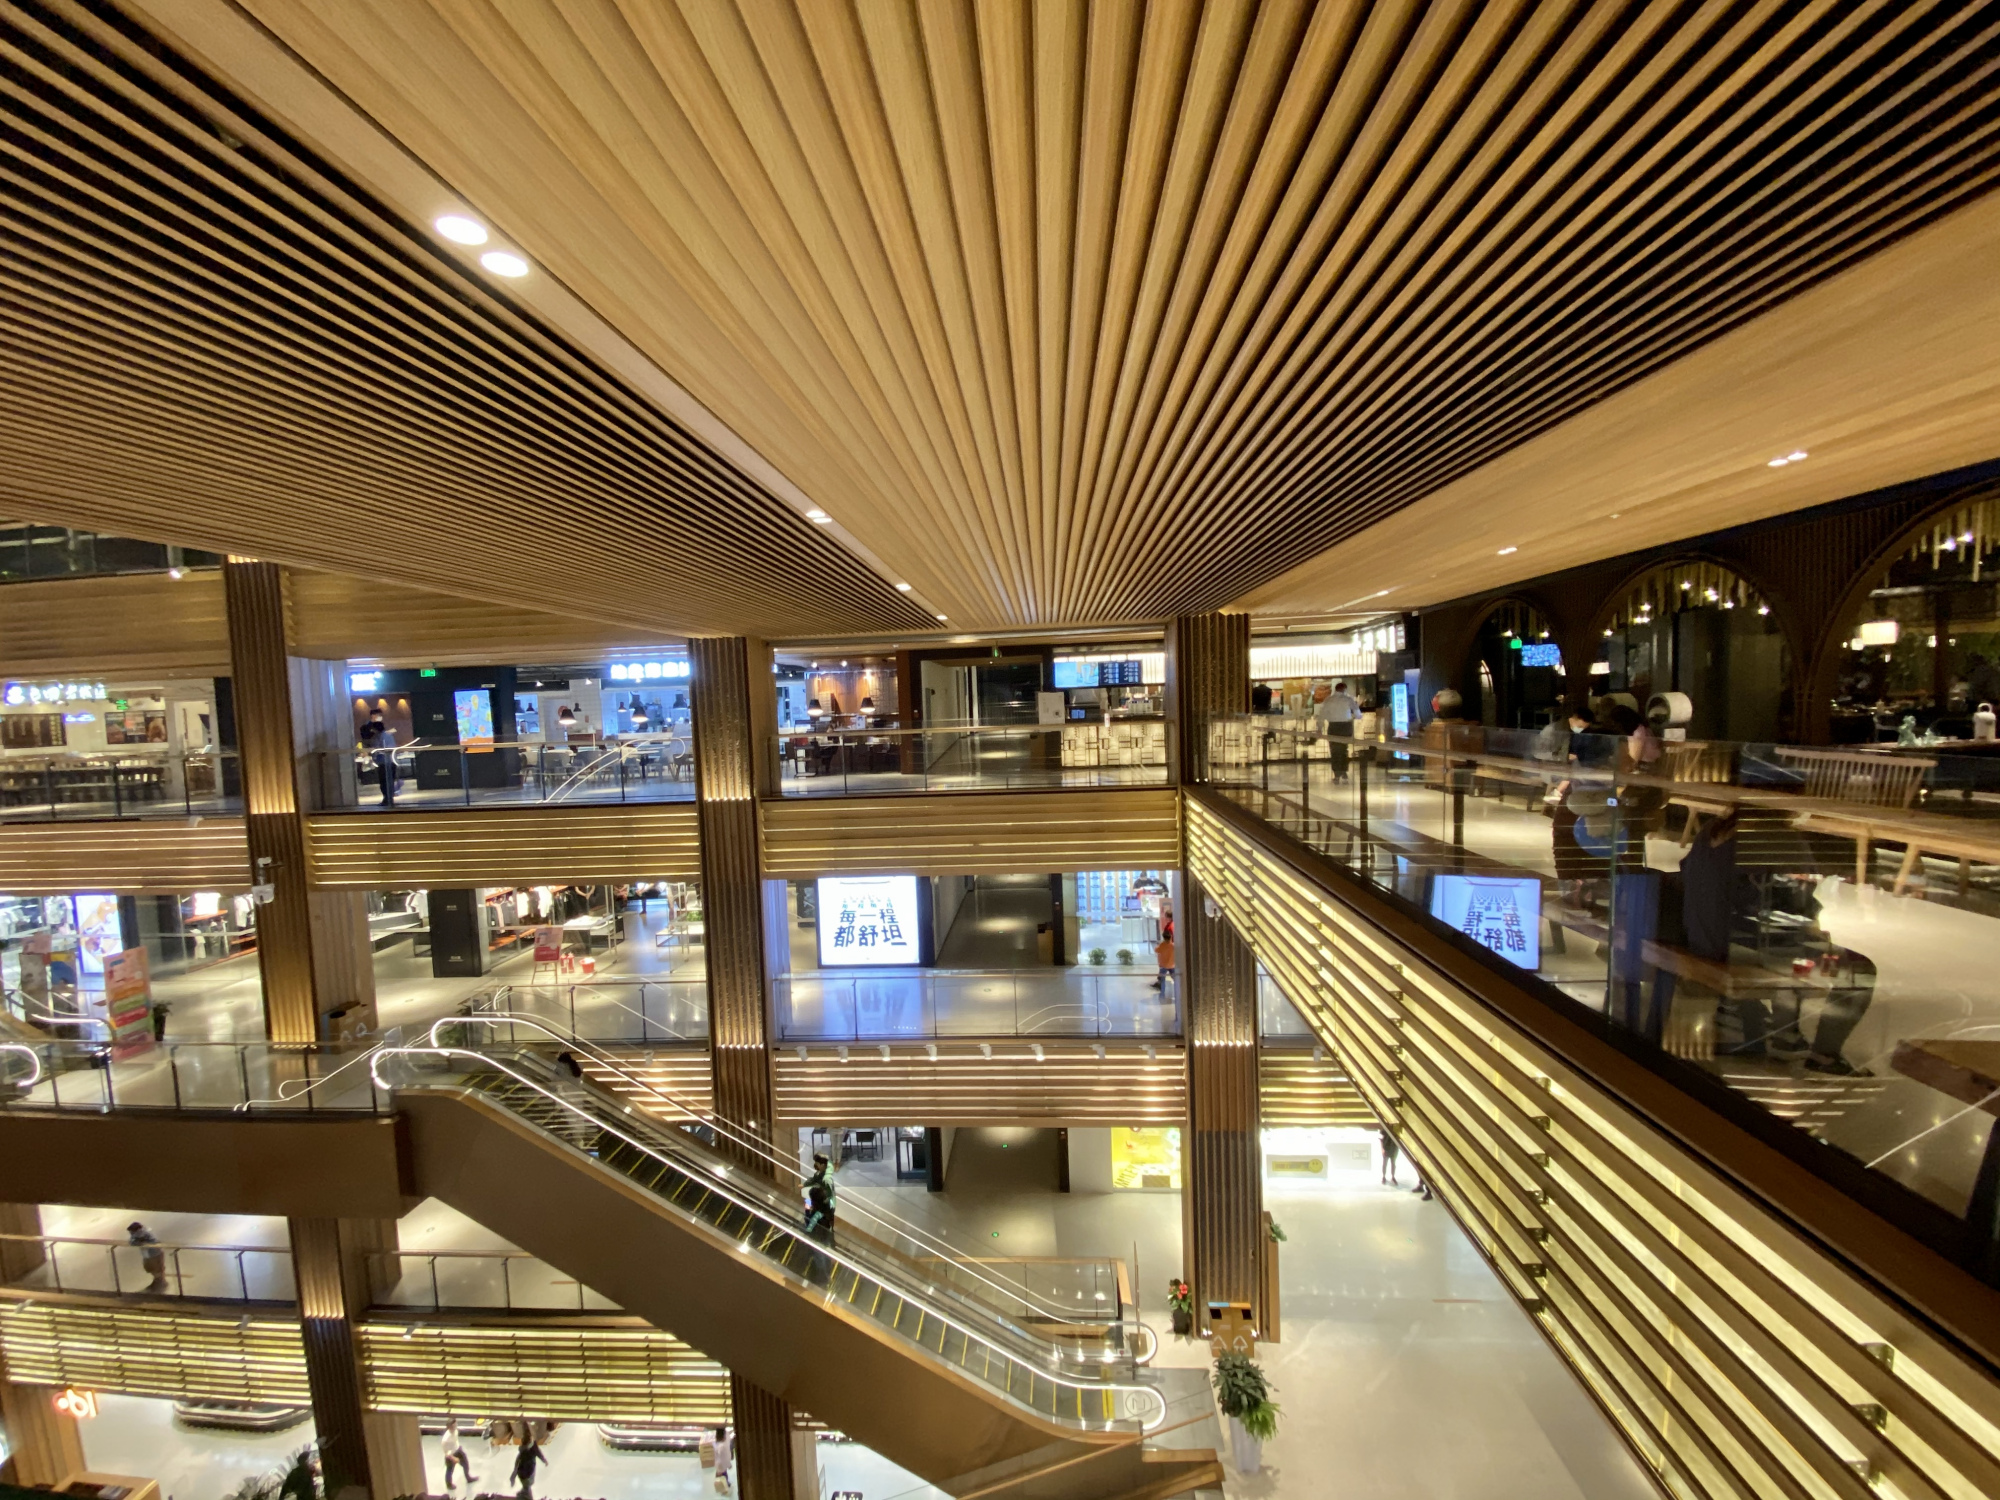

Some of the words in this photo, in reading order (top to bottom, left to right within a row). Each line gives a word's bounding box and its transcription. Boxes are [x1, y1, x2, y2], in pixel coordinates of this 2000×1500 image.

[840, 909, 899, 925] 每一程
[833, 924, 907, 948] 都舒坦
